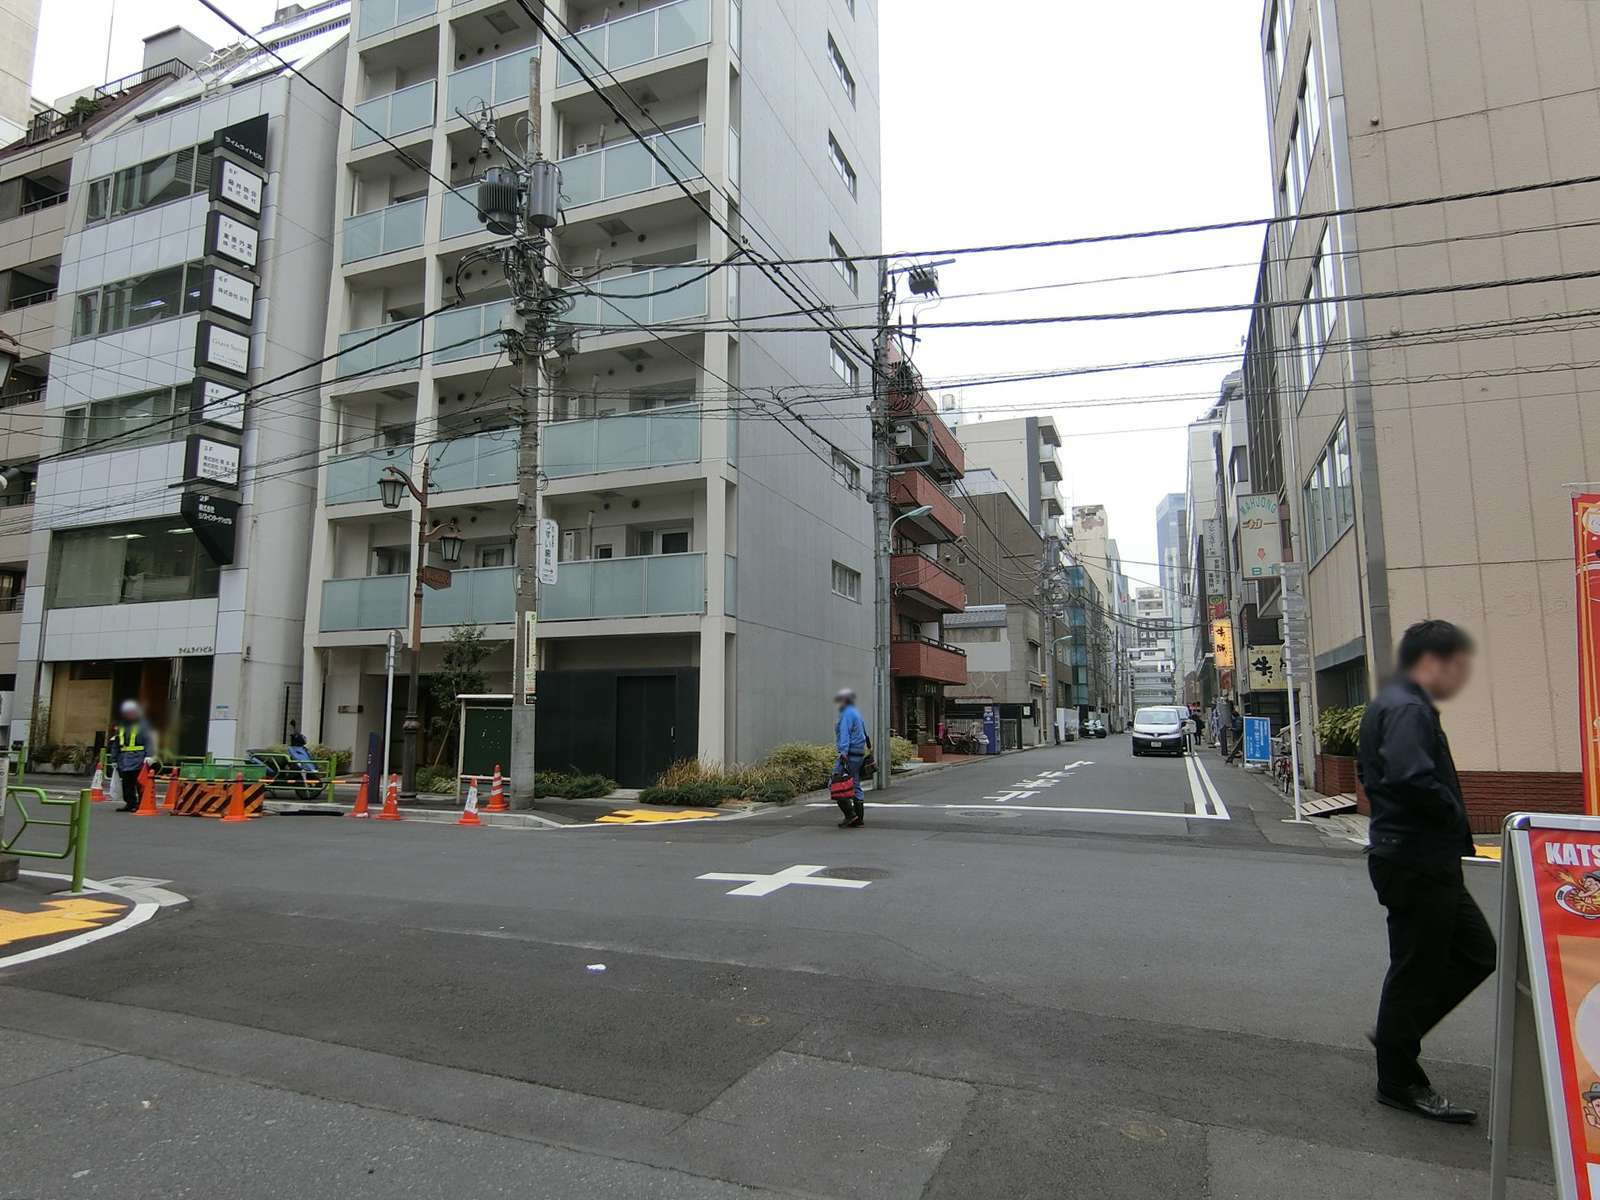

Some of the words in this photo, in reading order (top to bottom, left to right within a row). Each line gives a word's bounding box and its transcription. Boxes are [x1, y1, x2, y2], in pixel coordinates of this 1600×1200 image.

[224, 135, 264, 161] ライムライトビル
[227, 185, 257, 205] 株式会社
[222, 239, 252, 258] 株式会社
[1239, 497, 1278, 516] MAHJONG
[178, 646, 213, 655] ライムライトビル
